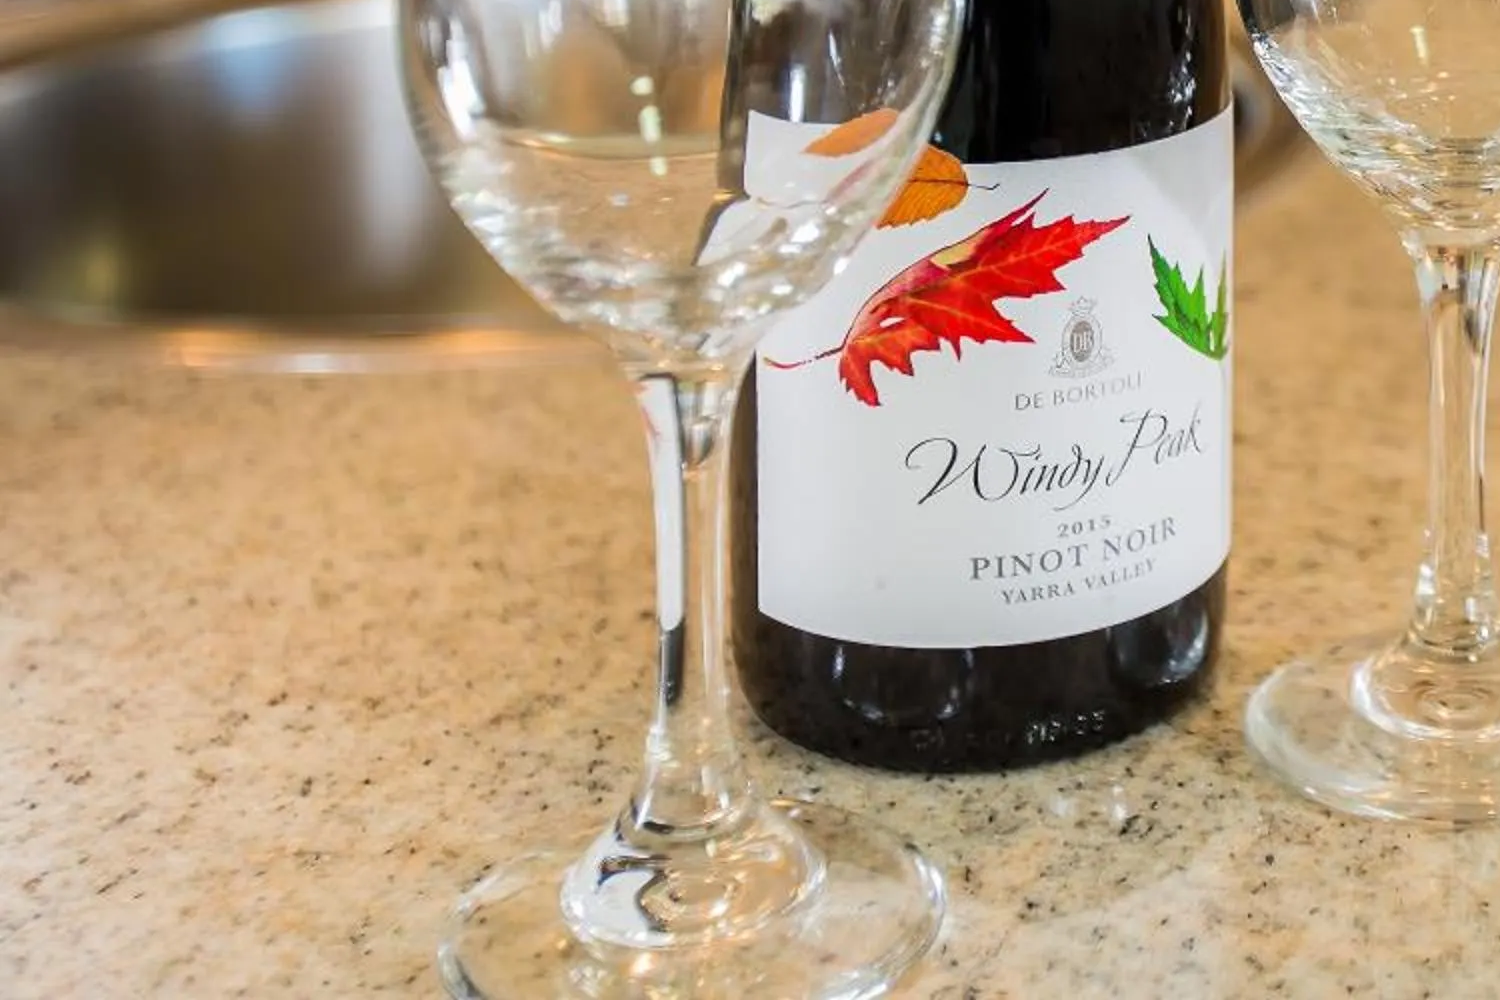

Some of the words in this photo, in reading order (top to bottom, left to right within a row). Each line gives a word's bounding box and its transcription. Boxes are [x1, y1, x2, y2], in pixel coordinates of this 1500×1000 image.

[1015, 391, 1045, 411] DE
[1053, 370, 1142, 406] BORTOLI
[905, 437, 1104, 512] Windy
[1105, 402, 1204, 487] Peak
[969, 543, 1089, 580] PINOT
[1102, 516, 1177, 562] NOIR
[1056, 515, 1112, 538] 2015
[1001, 580, 1076, 605] YARRA
[1083, 557, 1157, 591] VALLEY
